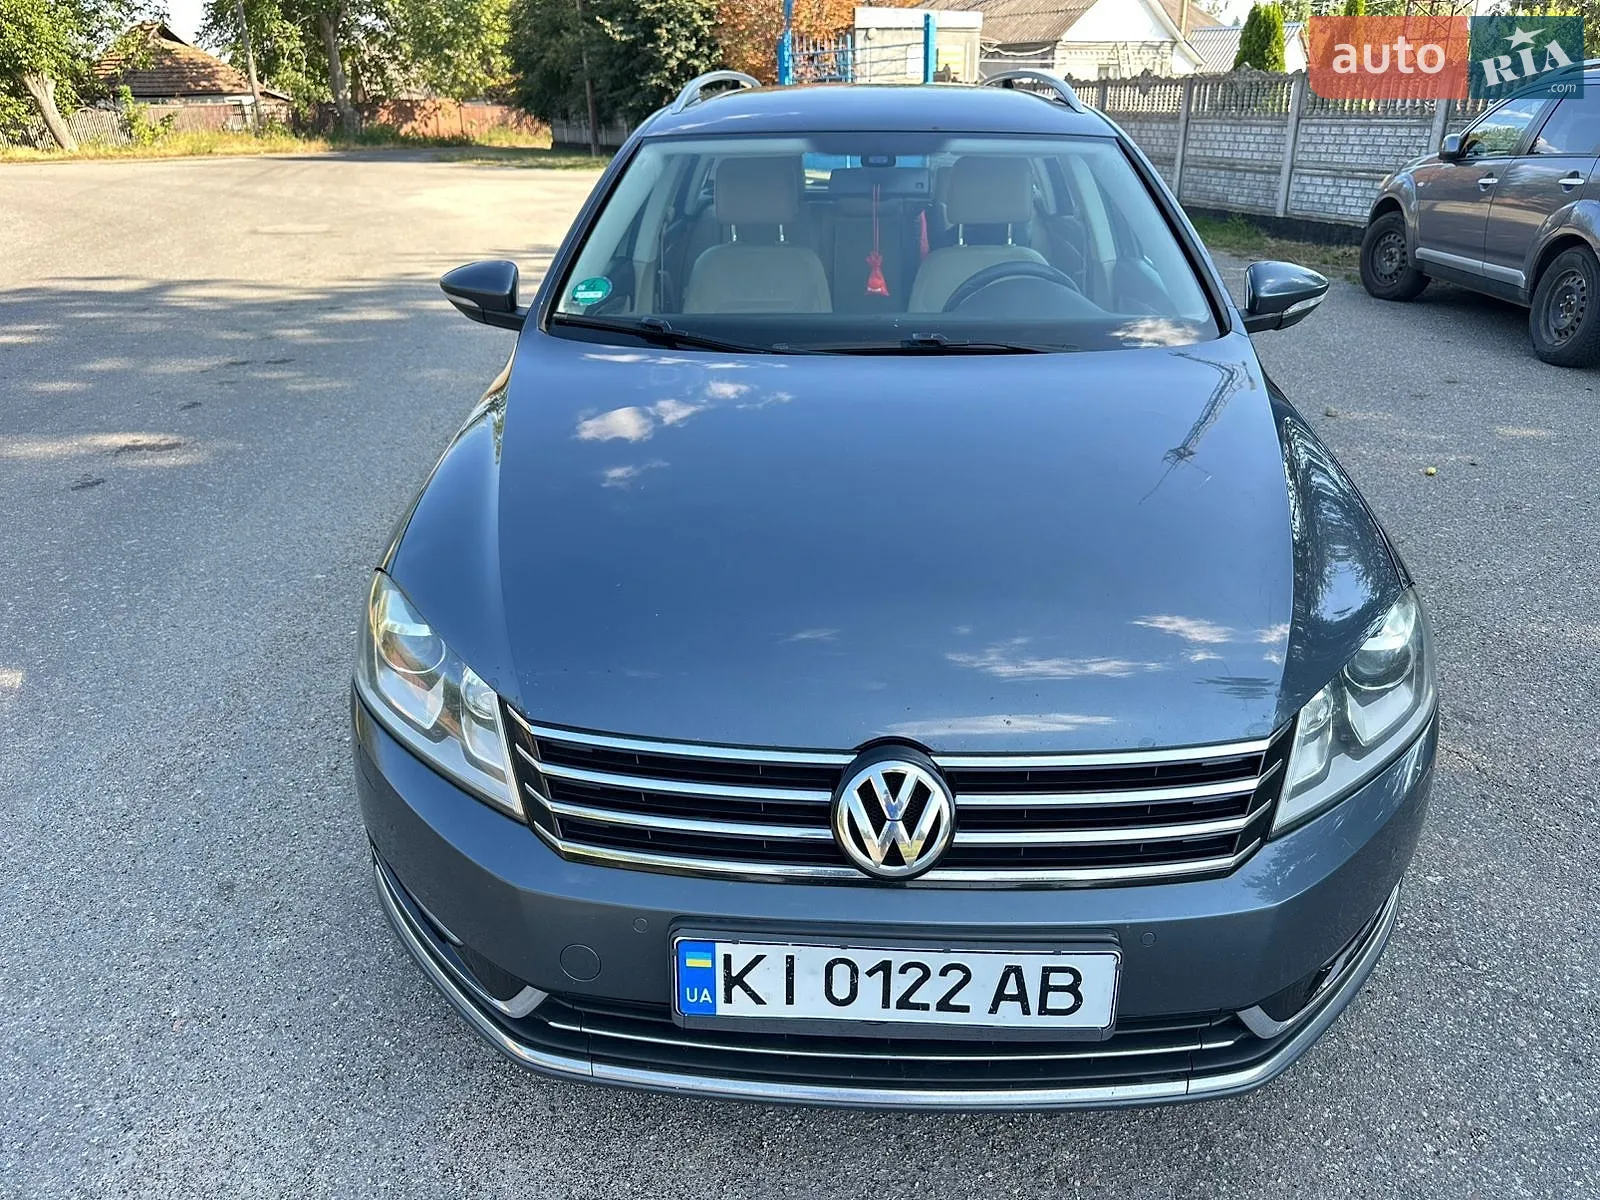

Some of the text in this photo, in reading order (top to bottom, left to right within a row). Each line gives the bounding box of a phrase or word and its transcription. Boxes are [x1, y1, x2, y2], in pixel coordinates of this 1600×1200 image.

[842, 764, 946, 872] VW
[686, 987, 712, 1004] UA
[723, 953, 1084, 1017] KI 0122 AB
